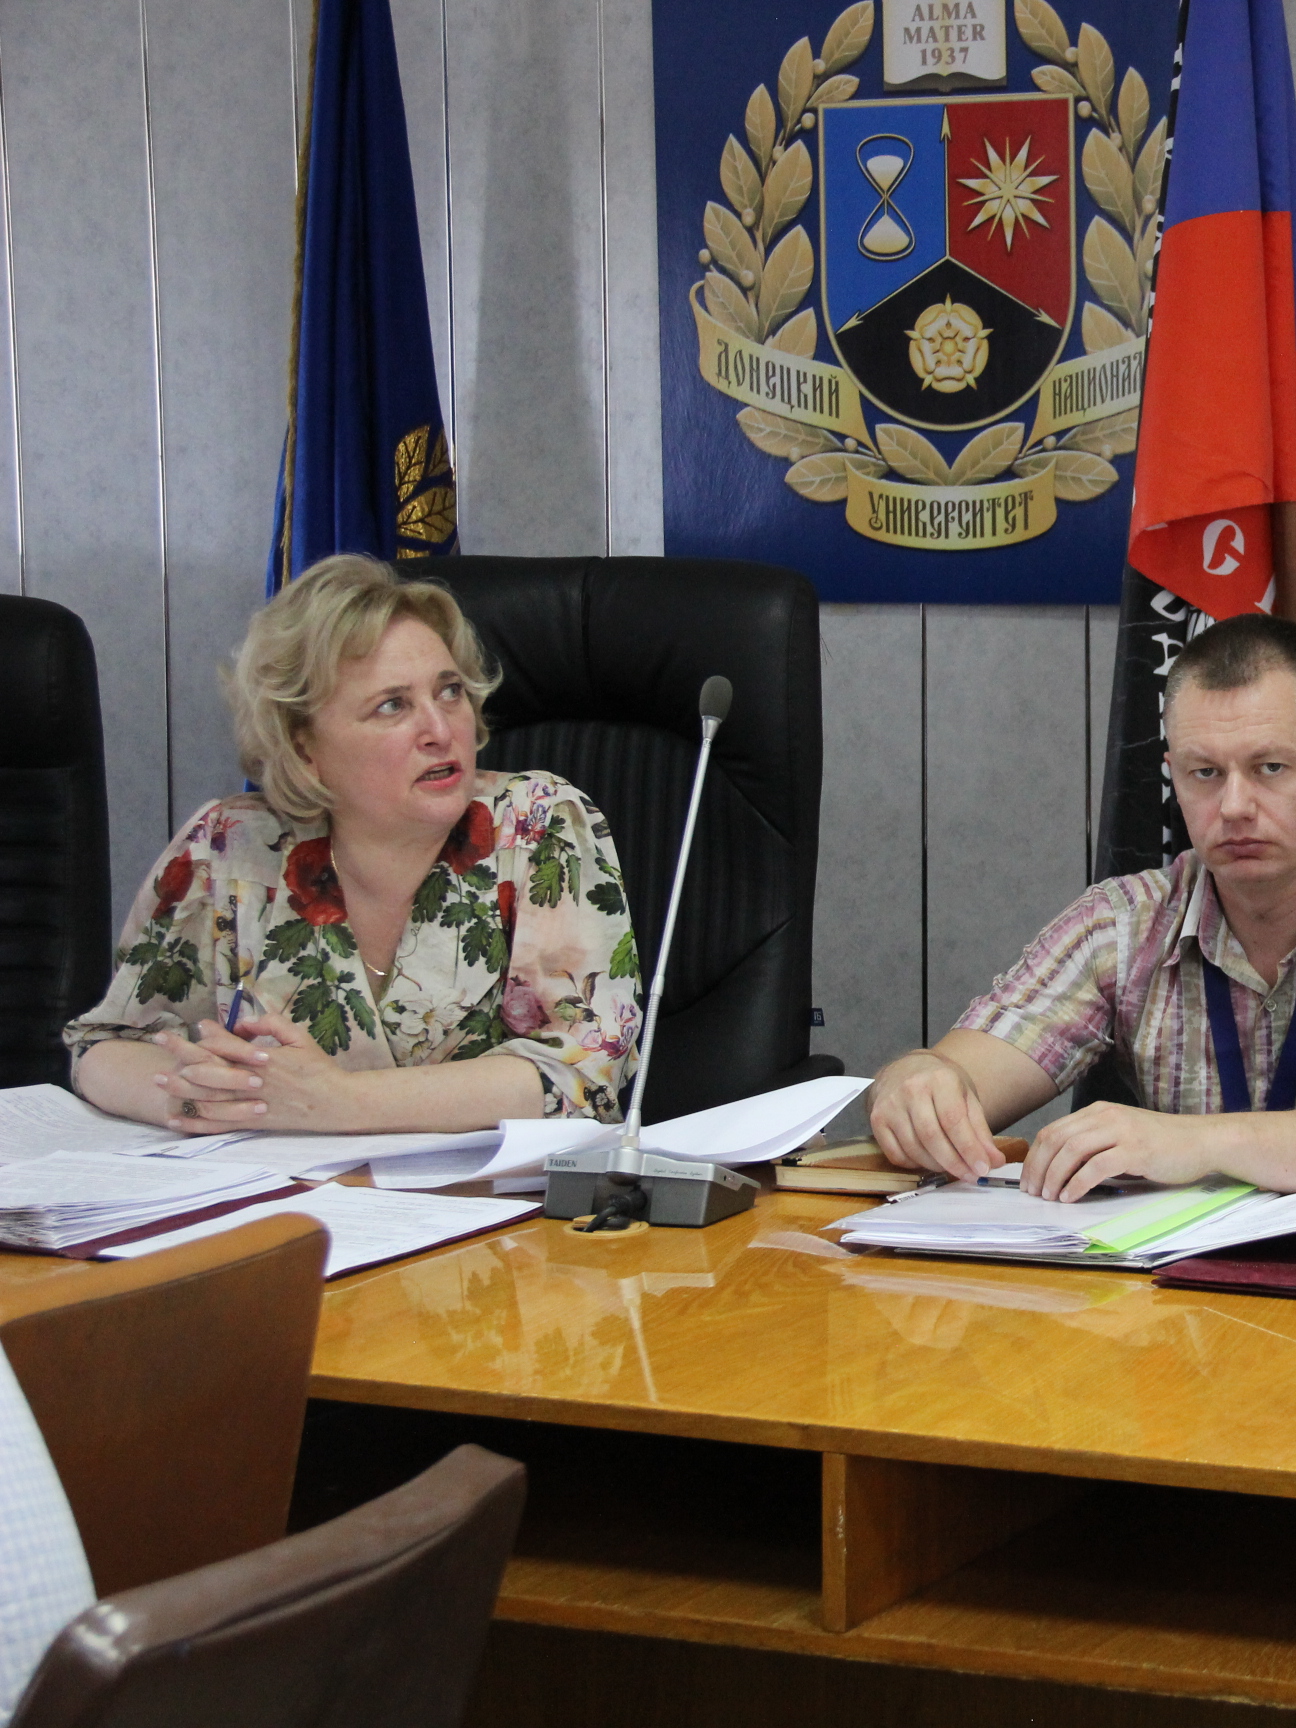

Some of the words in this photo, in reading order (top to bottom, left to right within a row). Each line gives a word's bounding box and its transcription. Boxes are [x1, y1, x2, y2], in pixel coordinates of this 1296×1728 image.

[911, 1, 977, 22] ALMA
[903, 24, 986, 45] MATER
[920, 46, 969, 66] 1937
[716, 338, 840, 419] ДОНЕЦКИЙ
[868, 490, 1034, 539] УНИВЕРСИТЕТ
[549, 1159, 578, 1167] TAIDEN
